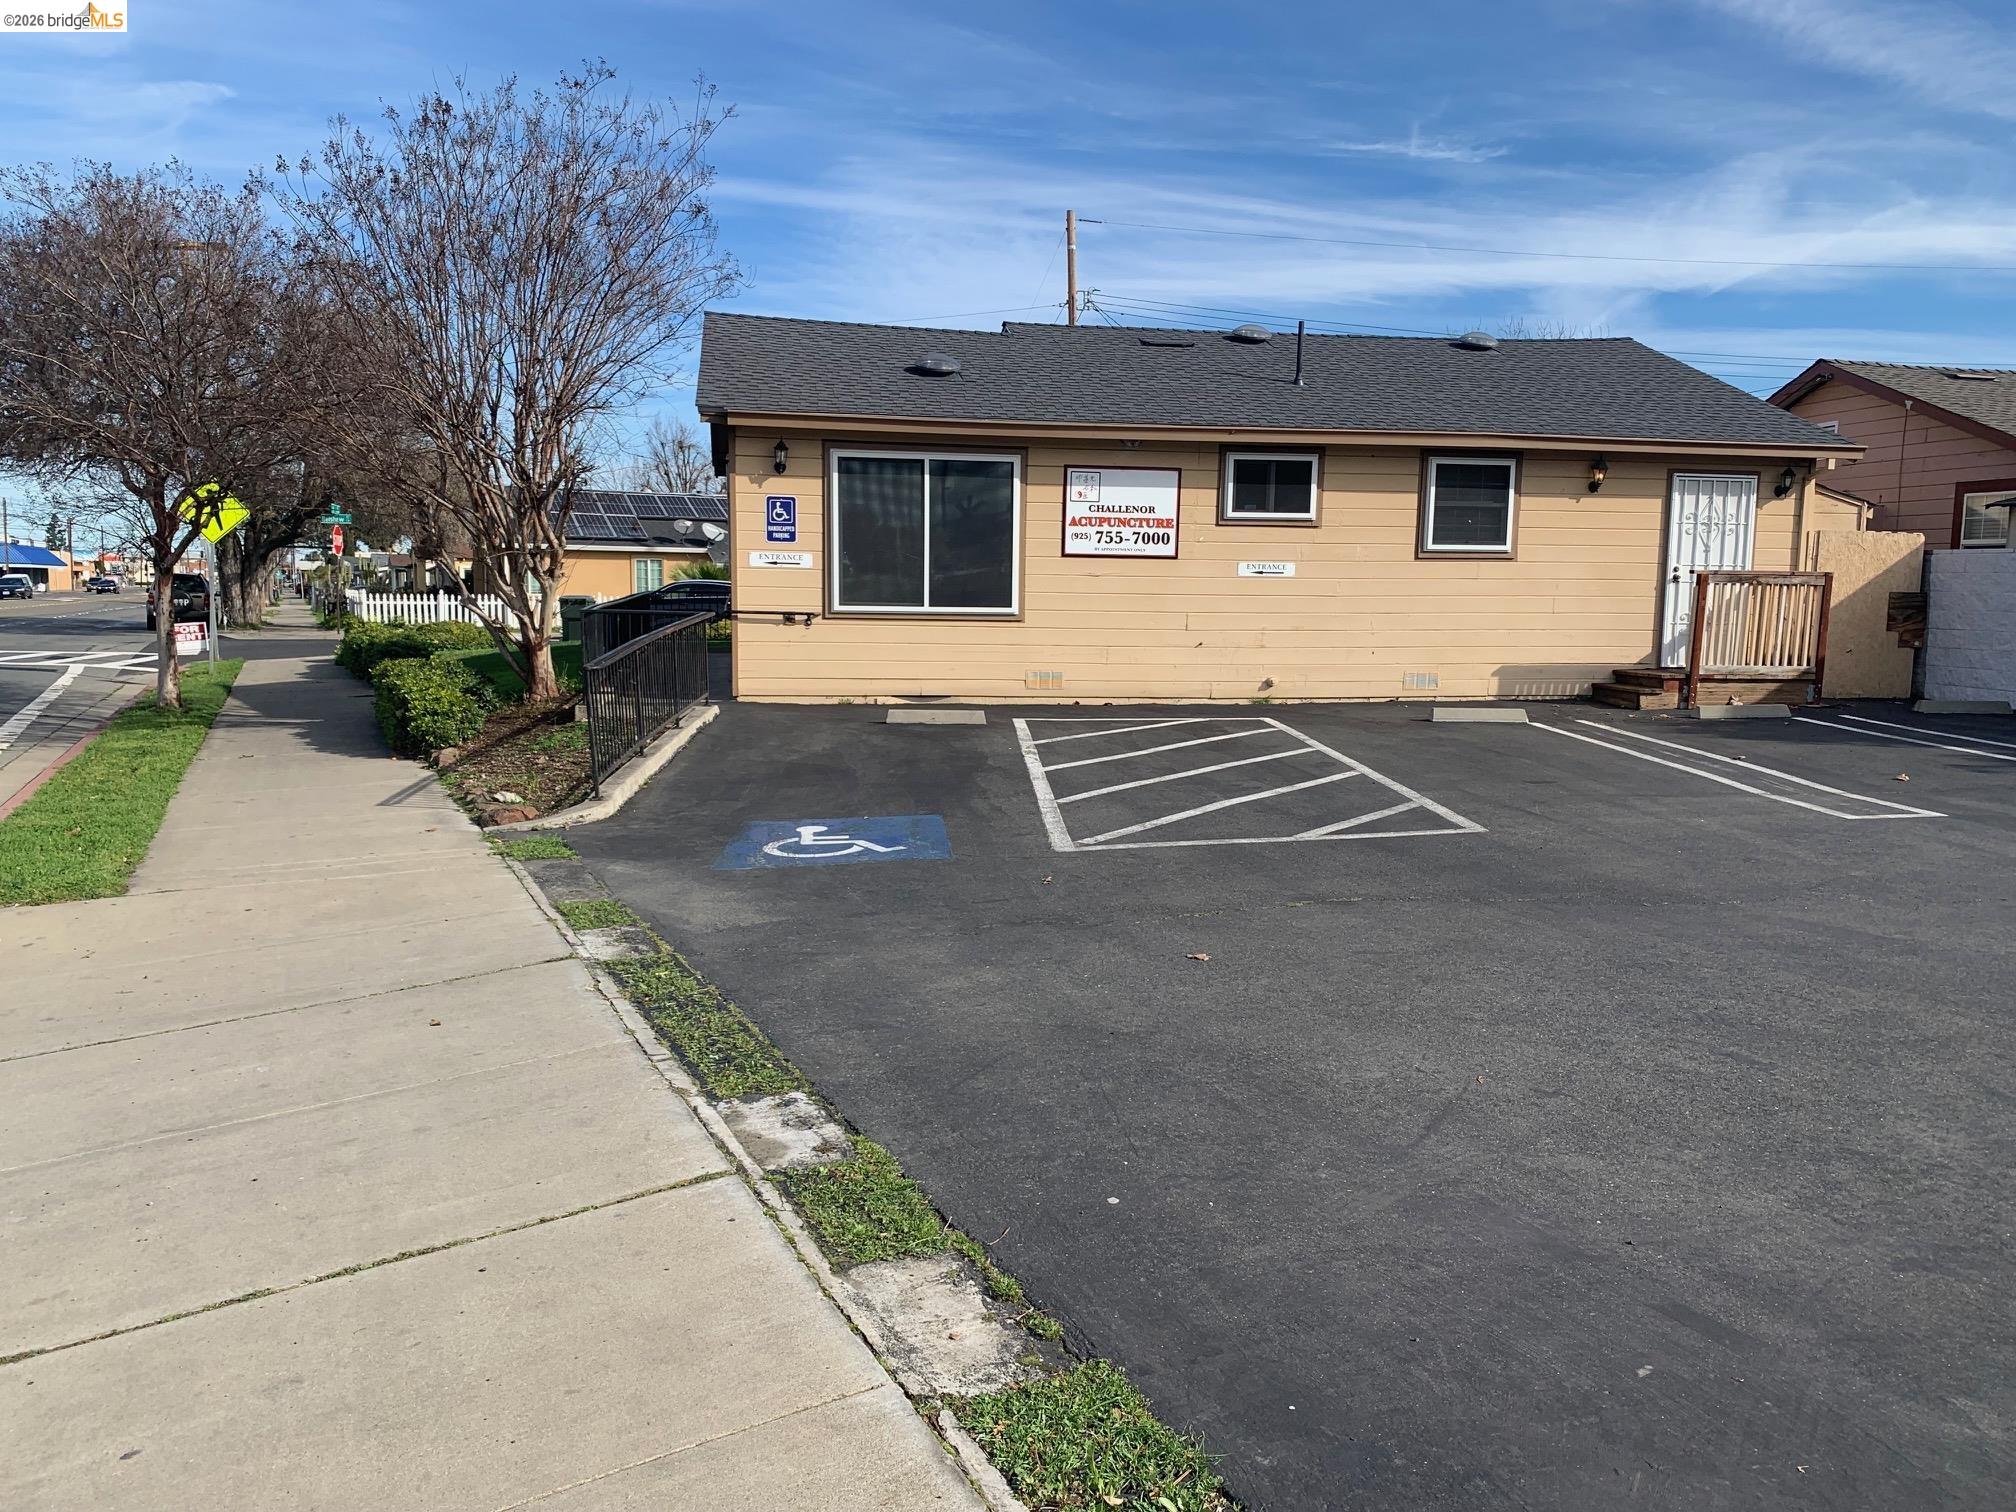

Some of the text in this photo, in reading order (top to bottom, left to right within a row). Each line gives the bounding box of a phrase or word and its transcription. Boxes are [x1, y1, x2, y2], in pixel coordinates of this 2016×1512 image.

[1088, 504, 1156, 514] CHALLENOR
[1068, 516, 1175, 529] ACUPUNCTURE
[1071, 530, 1171, 545] (925) 755-7000
[759, 553, 804, 561] ENTRANCE
[1246, 563, 1288, 571] ENTRANCE
[175, 632, 204, 641] ENT
